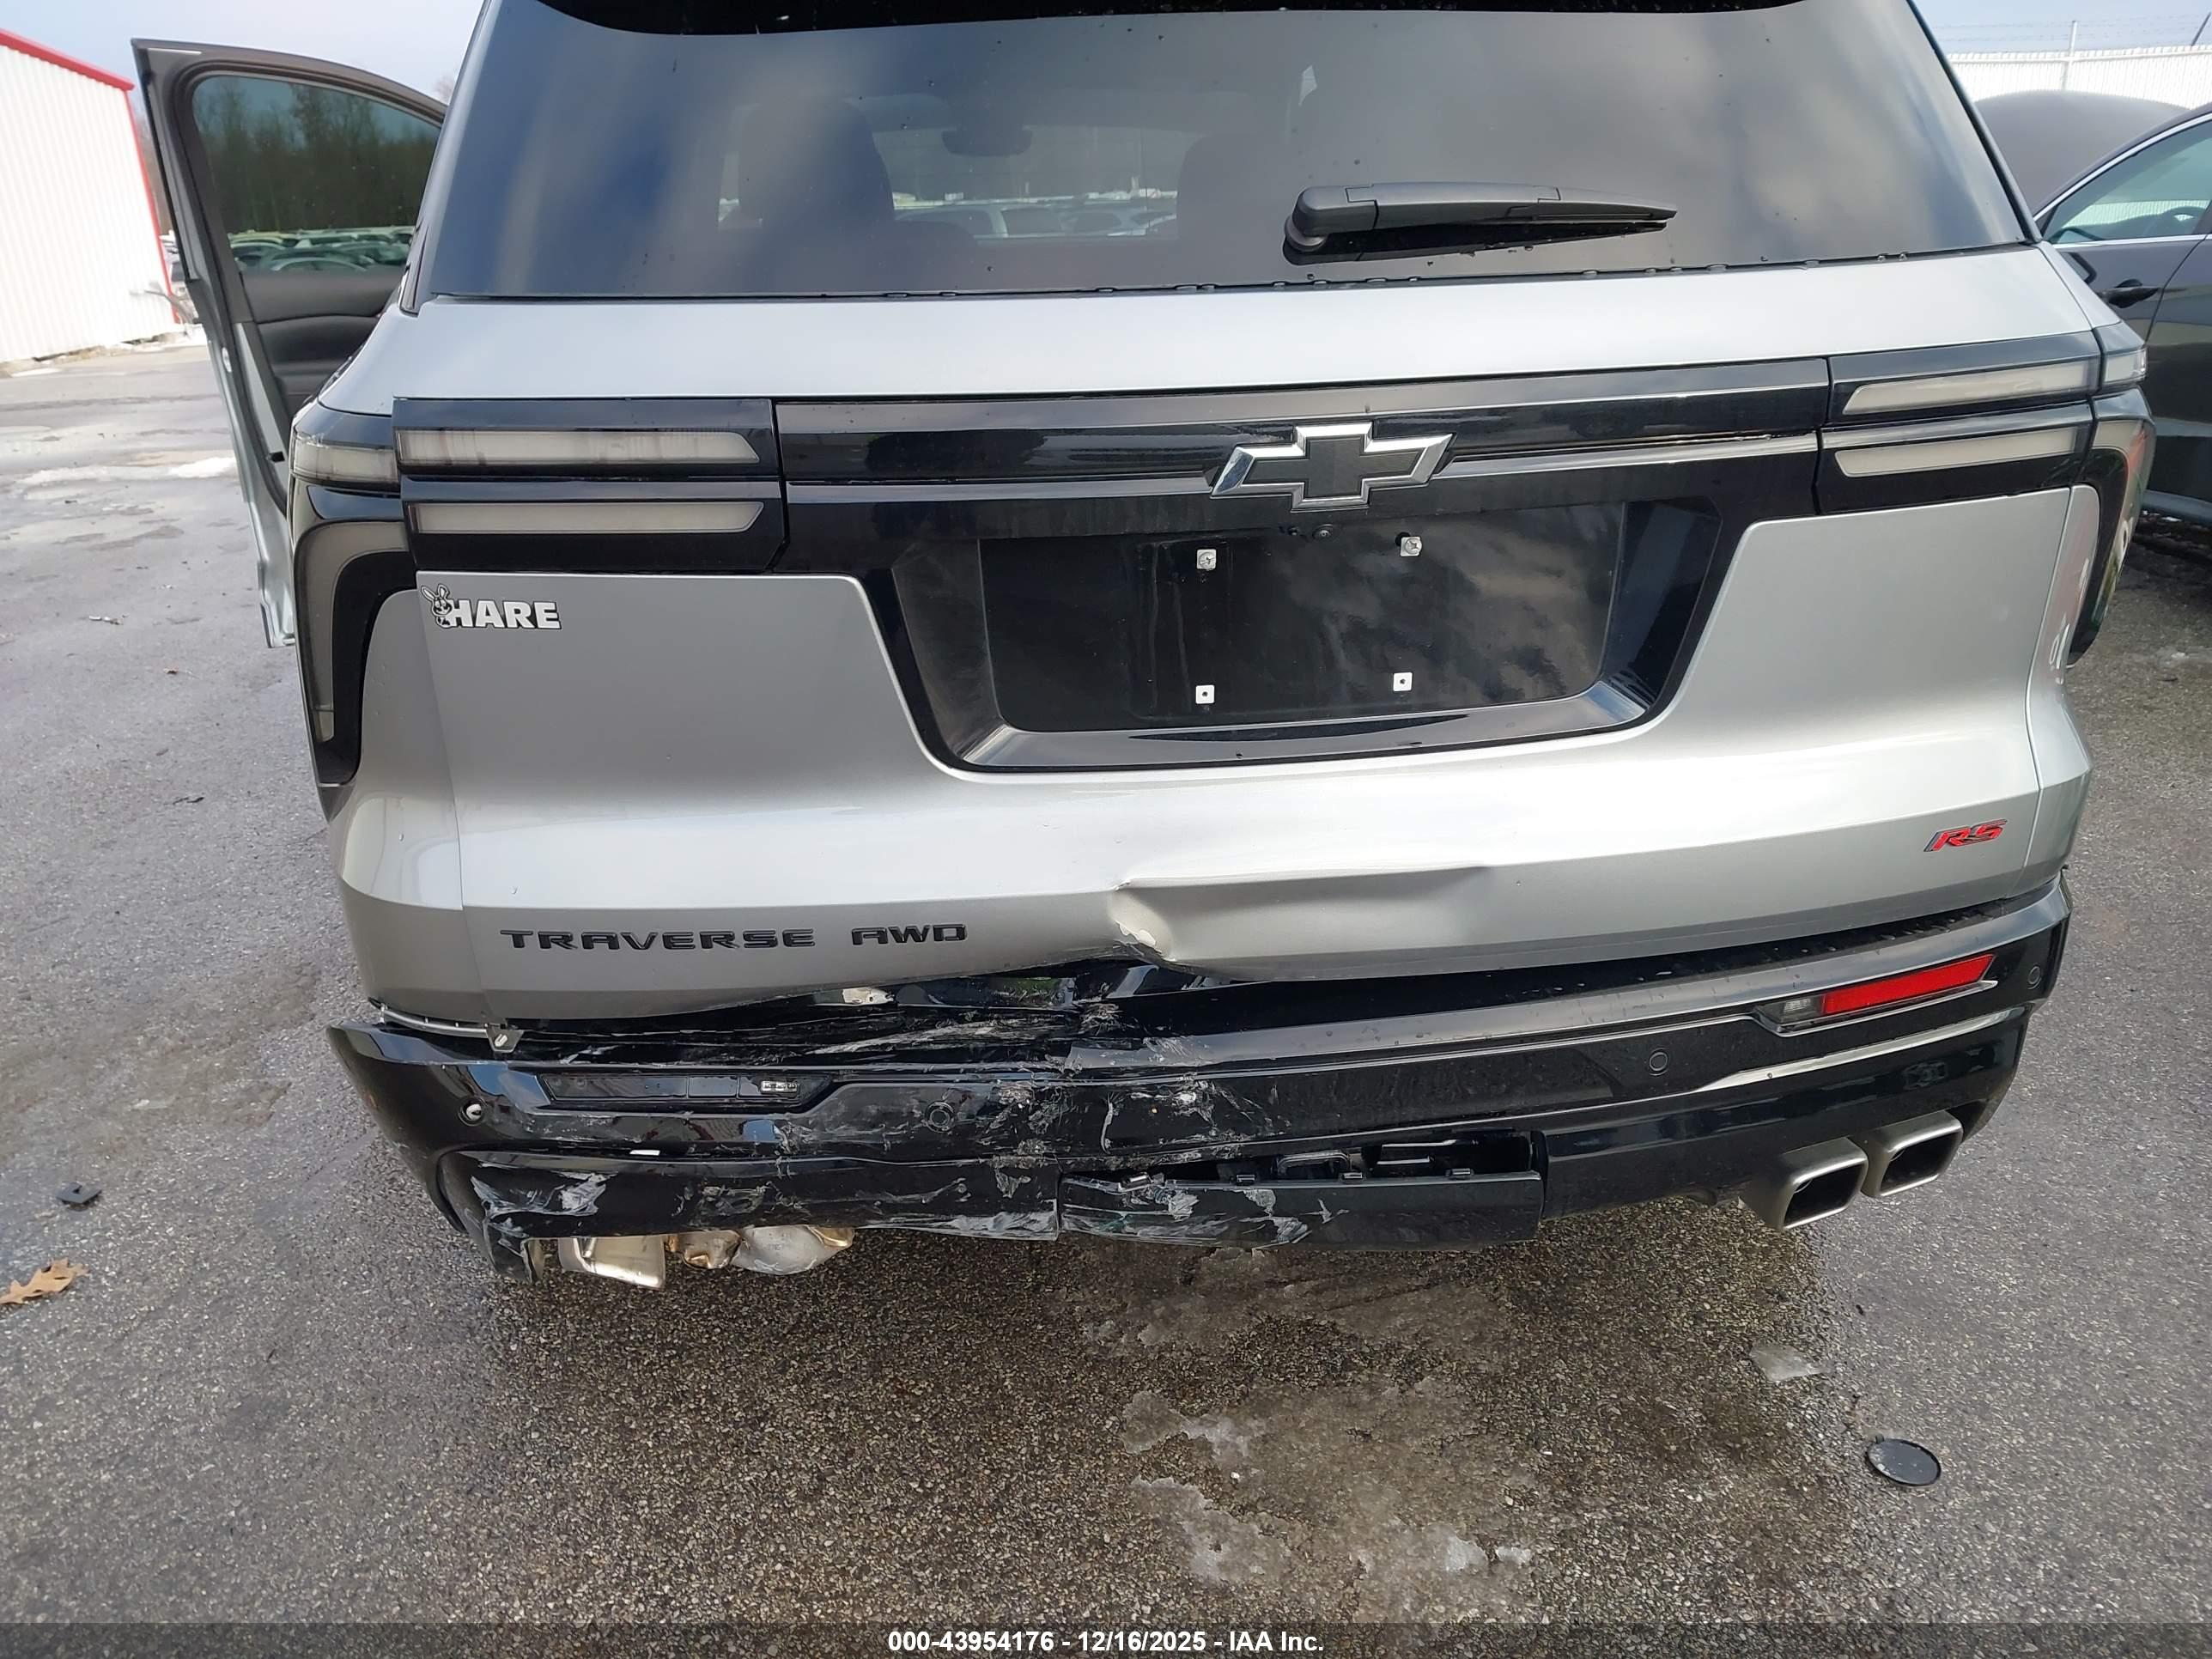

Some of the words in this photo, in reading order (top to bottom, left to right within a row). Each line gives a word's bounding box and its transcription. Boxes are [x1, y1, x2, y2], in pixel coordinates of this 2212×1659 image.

[447, 599, 562, 629] HARE
[1923, 819, 2008, 853] RS
[500, 929, 816, 950] TRAVERSE
[851, 924, 968, 945] AWD
